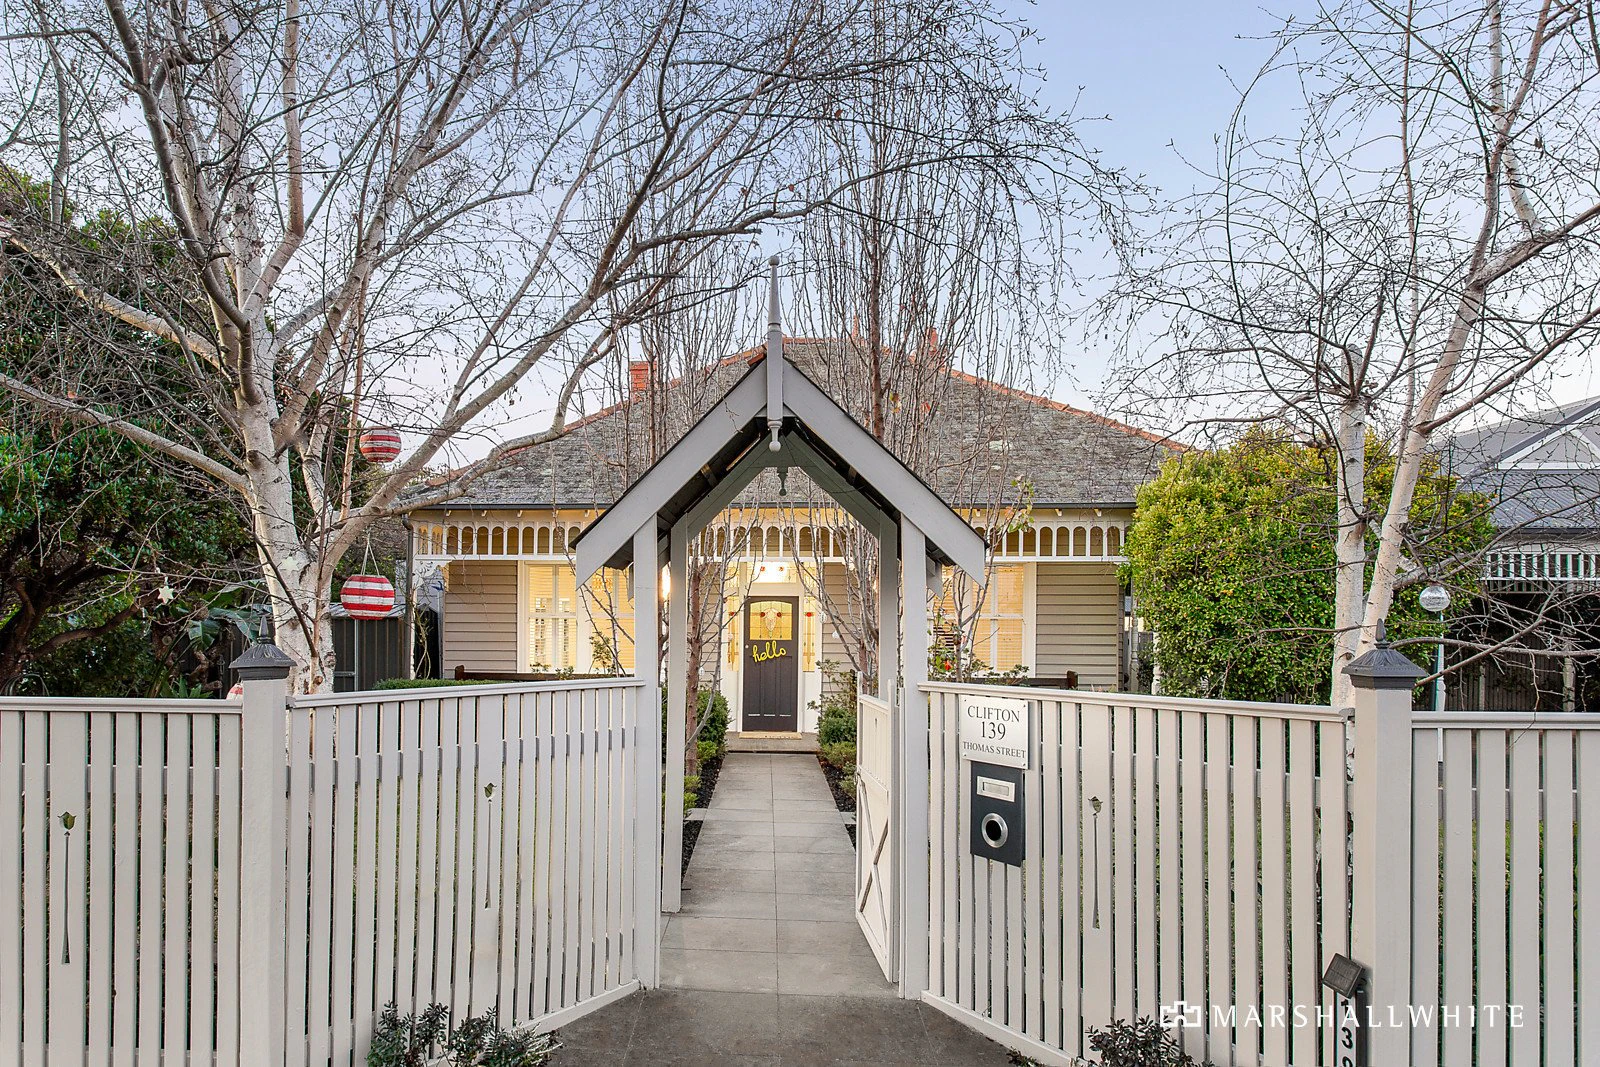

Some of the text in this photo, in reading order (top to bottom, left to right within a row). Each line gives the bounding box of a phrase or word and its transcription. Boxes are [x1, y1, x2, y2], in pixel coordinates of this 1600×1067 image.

[752, 640, 787, 663] hello
[967, 705, 1020, 723] CLIFTON
[981, 721, 1006, 740] 139
[963, 741, 1027, 759] THOMAS STREET
